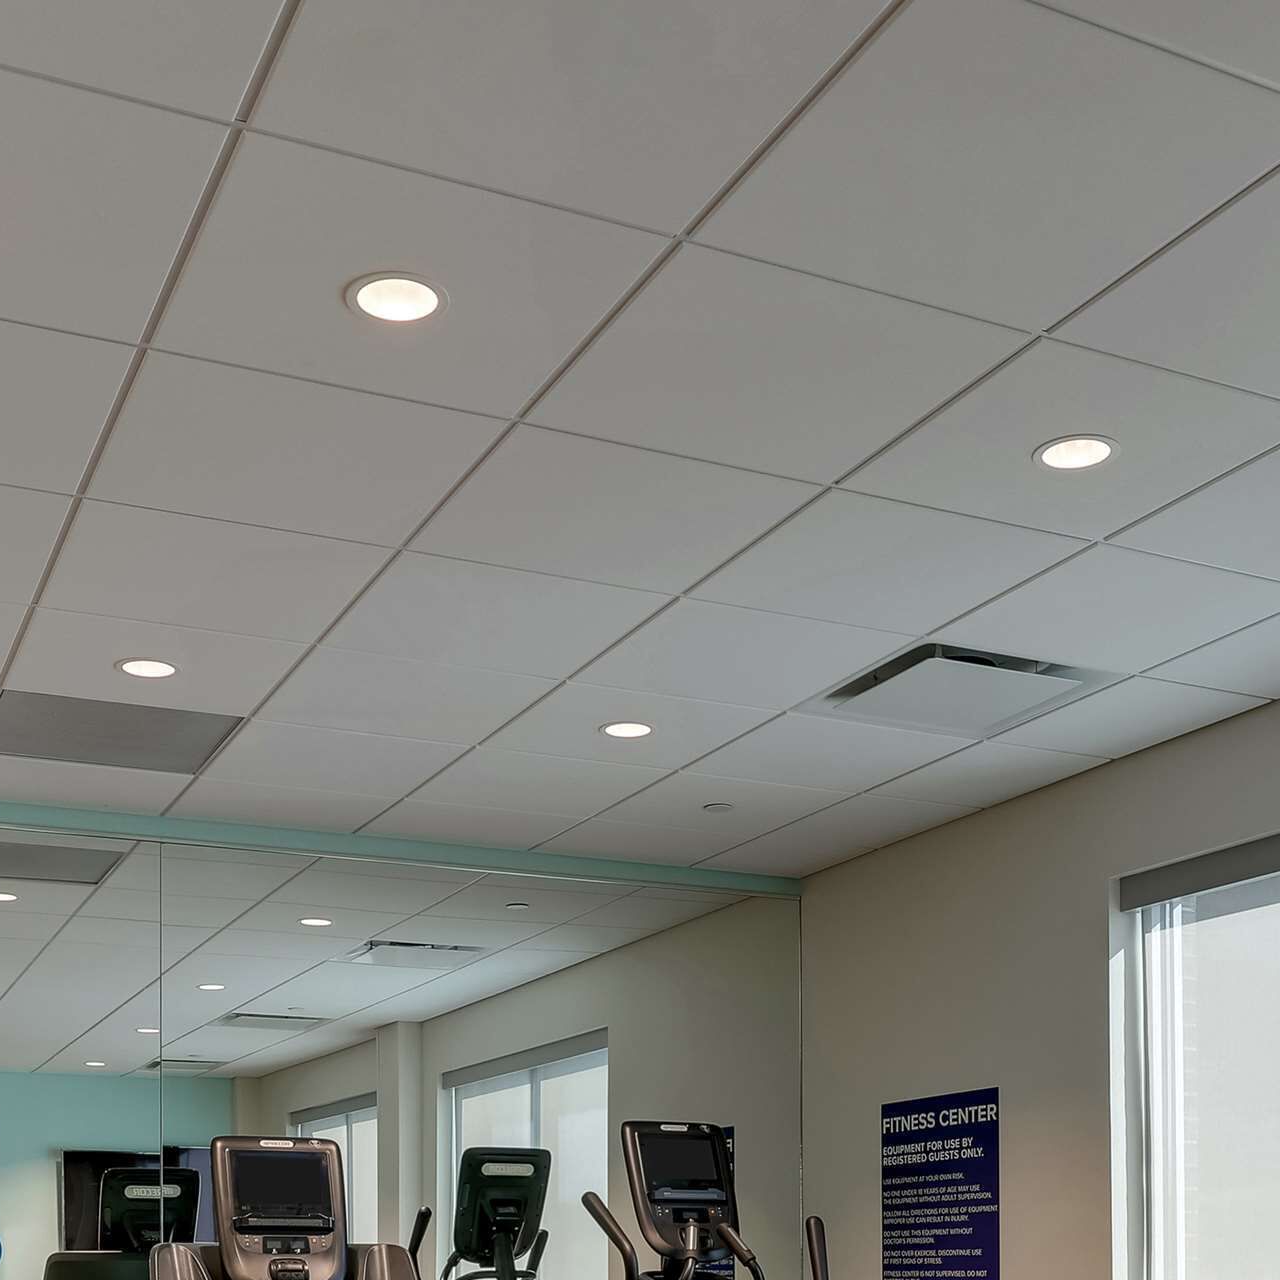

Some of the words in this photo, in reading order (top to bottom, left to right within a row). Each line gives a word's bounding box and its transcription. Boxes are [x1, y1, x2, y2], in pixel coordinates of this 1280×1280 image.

[882, 1111, 936, 1134] FITNESS
[939, 1104, 997, 1126] CENTER
[882, 1143, 925, 1156] EQUIPMENT
[926, 1140, 943, 1151] FOR
[944, 1138, 960, 1149] USE
[962, 1137, 973, 1147] BY
[882, 1153, 927, 1166] REGISTERED
[928, 1150, 960, 1161] GUESTS
[961, 1147, 984, 1158] ONLY.
